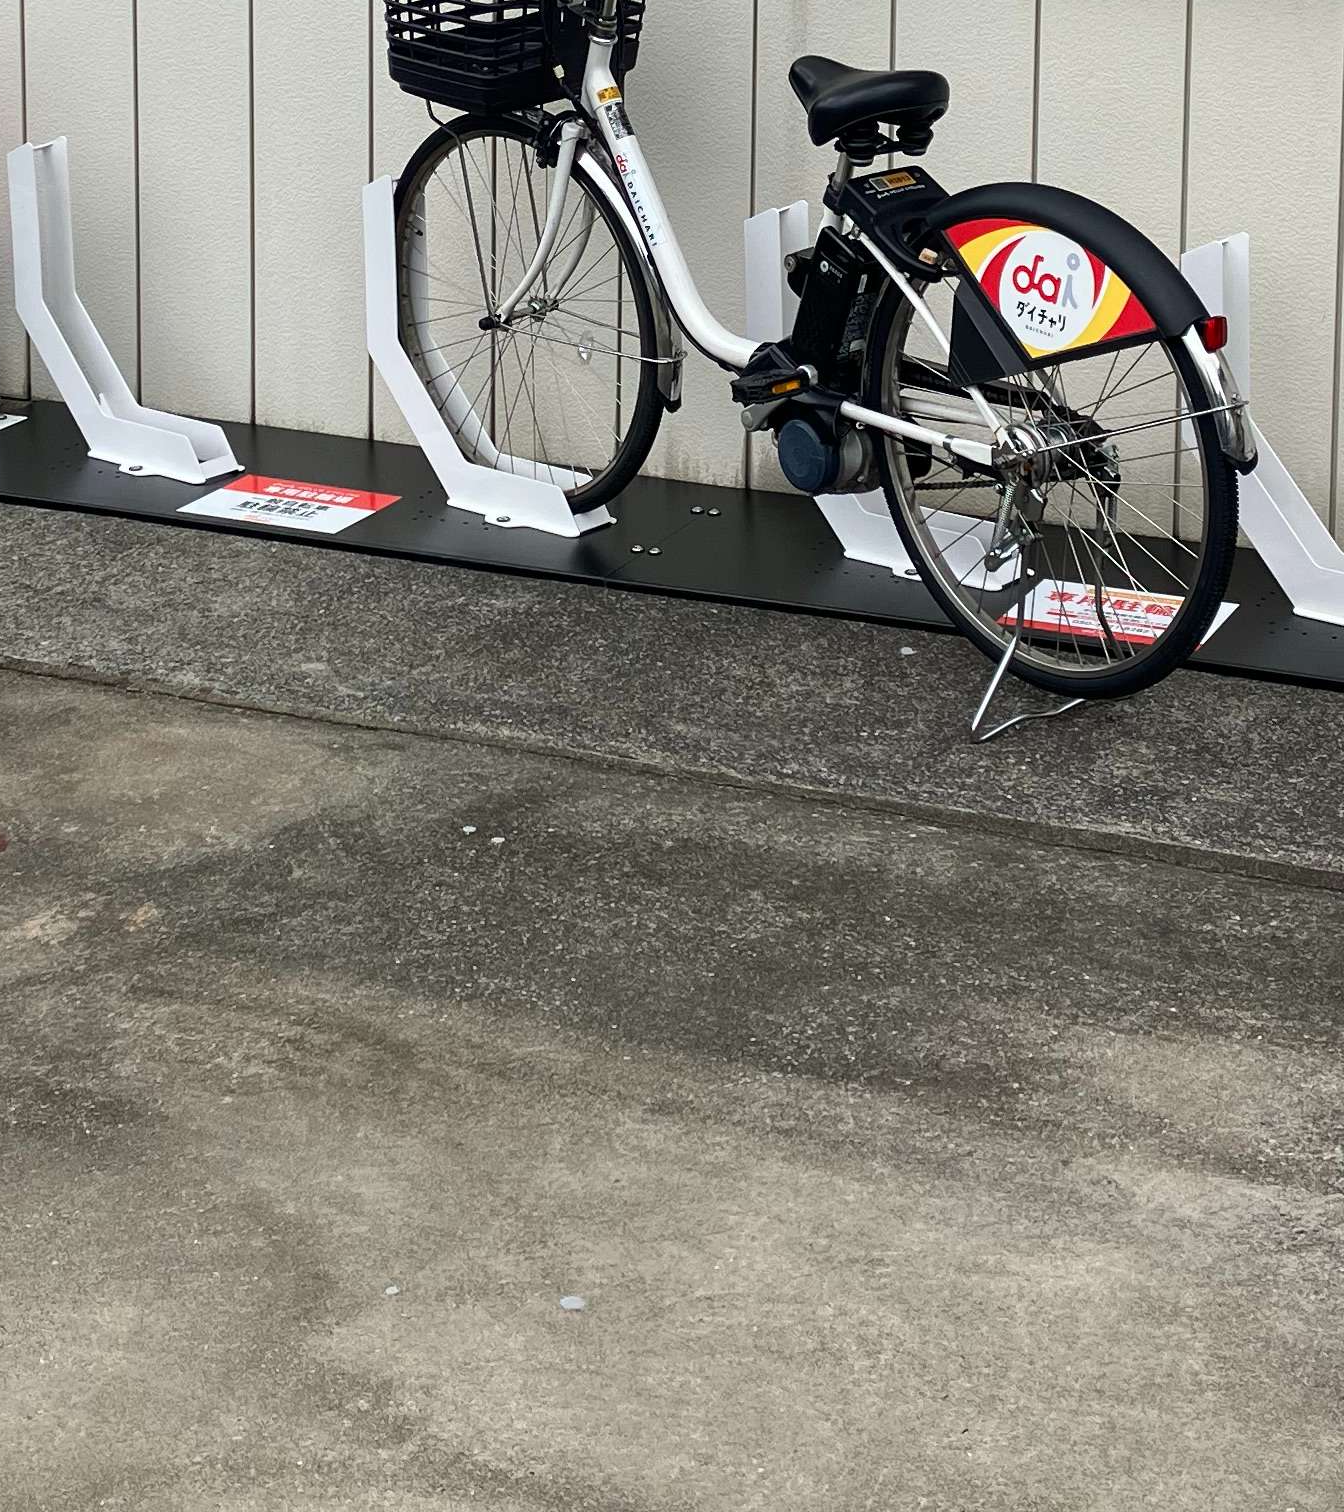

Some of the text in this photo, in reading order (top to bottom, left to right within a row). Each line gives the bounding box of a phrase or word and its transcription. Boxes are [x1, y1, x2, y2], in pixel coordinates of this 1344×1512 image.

[626, 181, 659, 248] DAICHARI
[1012, 252, 1081, 310] dai
[1016, 300, 1067, 332] ダイチャリ
[1044, 590, 1177, 617] 専用駐輪
